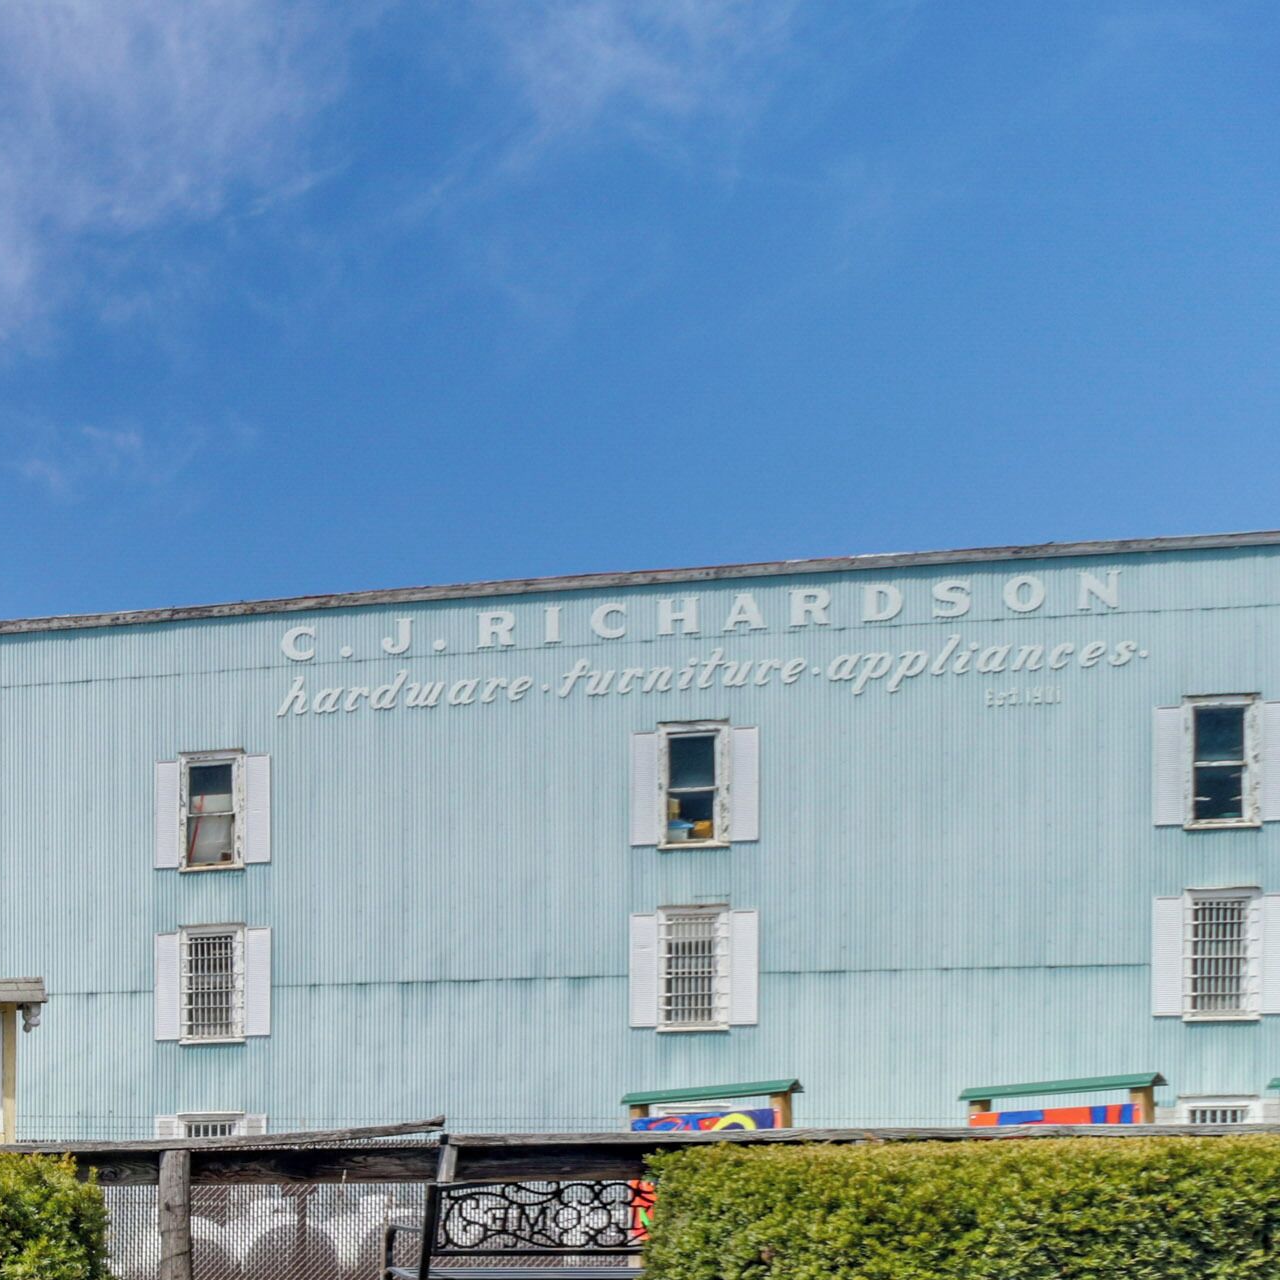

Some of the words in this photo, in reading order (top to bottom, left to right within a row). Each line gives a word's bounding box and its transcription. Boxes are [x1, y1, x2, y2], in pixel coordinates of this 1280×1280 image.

[476, 569, 1123, 649] RICHARDSON
[276, 668, 533, 718] hardware
[558, 647, 807, 698] furniture
